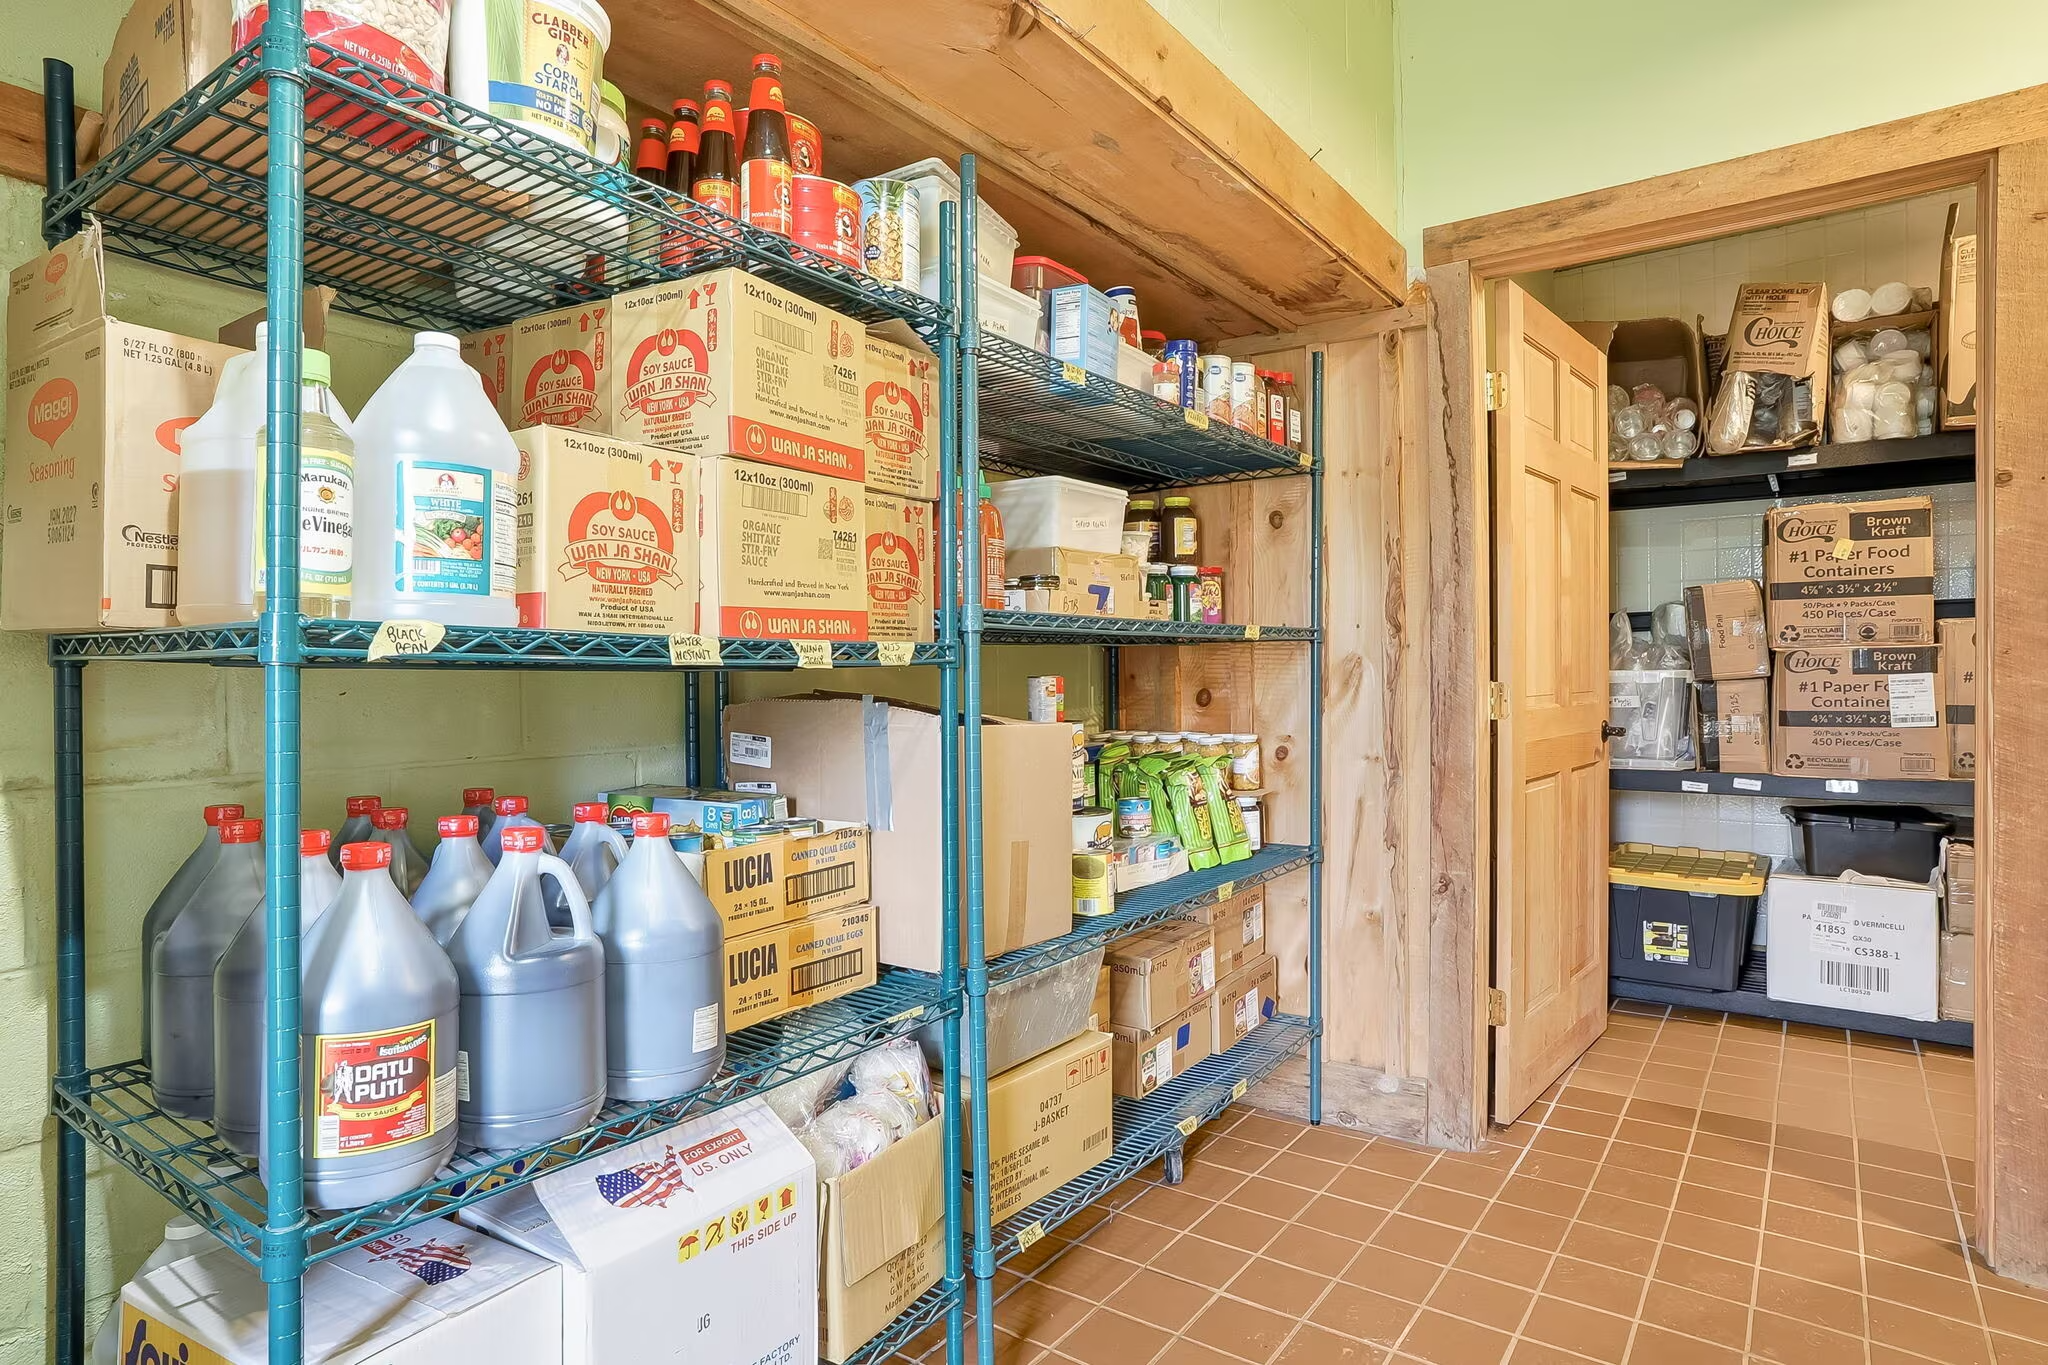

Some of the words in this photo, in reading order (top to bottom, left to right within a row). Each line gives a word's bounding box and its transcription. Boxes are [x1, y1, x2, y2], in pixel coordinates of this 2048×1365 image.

[532, 13, 589, 48] CLABBER
[548, 27, 578, 49] GIRL
[543, 63, 578, 87] CORN
[535, 72, 583, 102] STARCH
[624, 296, 654, 309] 12x10oz
[655, 290, 683, 304] (300ml)
[743, 281, 783, 310] 12x10oz
[784, 298, 818, 325] (300ml)
[1744, 316, 1804, 348] CHOICE
[123, 348, 141, 359] NET
[145, 353, 162, 364] 1.25
[165, 357, 182, 368] GAL
[185, 362, 202, 372] (4.8
[149, 343, 158, 353] FL
[162, 346, 173, 356] OZ
[176, 349, 195, 361] (800
[755, 346, 789, 367] ORGANIC
[643, 363, 661, 376] SOY
[663, 358, 693, 373] SAUCE
[833, 364, 857, 381] 74261
[756, 370, 788, 388] STIR-FRY
[628, 384, 652, 401] WAN
[659, 378, 675, 391] JA
[676, 376, 706, 391] SHAN
[757, 381, 779, 397] SAUCE
[34, 393, 72, 424] Maggi
[875, 405, 888, 416] SOY
[890, 408, 913, 423] SAUCE
[887, 421, 897, 433] JA
[900, 427, 922, 445] SHAN
[564, 438, 605, 455] 12x10oz
[607, 446, 643, 463] (300ml)
[770, 436, 800, 458] WAN
[802, 445, 815, 461] JA
[818, 449, 847, 468] SHAN
[29, 455, 76, 483] Seasoning
[733, 469, 777, 487] 12x10oz
[779, 476, 814, 494] (300ml)
[742, 520, 782, 533] ORGANIC
[1777, 517, 1838, 543] CHOICE
[1866, 515, 1911, 527] Brown
[591, 524, 615, 537] SOY
[618, 528, 656, 542] SAUCE
[742, 531, 781, 546] SHIITAKE
[832, 530, 857, 544] 74261
[1871, 526, 1907, 537] Kraft
[571, 543, 608, 562] WAN
[614, 544, 630, 557] JA
[634, 546, 672, 570] SHAN
[741, 543, 778, 557] STIR-FRY
[1789, 551, 1809, 563] #1
[1815, 549, 1862, 564] Paer
[1868, 544, 1910, 559] Food
[741, 554, 768, 568] SAUCE
[872, 558, 885, 567] SOY
[886, 559, 909, 569] SAUCE
[596, 566, 612, 580] NEW
[613, 568, 631, 582] YORK
[638, 570, 651, 583] USA
[1804, 564, 1895, 578] Containers
[592, 584, 628, 595] NATURALLY
[747, 578, 784, 587] Handcrafted
[785, 579, 796, 587] and
[797, 580, 817, 589] Brewed
[884, 572, 894, 582] JA
[895, 574, 918, 590] SHAN
[1802, 611, 1823, 619] 450
[1826, 609, 1896, 619] Pieces/Case
[387, 626, 426, 643] BLACK
[768, 618, 800, 634] WAN
[802, 618, 814, 634] JA
[817, 620, 850, 634] SHAN
[673, 636, 702, 646] WATER
[1784, 649, 1842, 674] CHOICE
[1873, 651, 1917, 661] Brown
[1878, 661, 1913, 671] Kraft
[1799, 681, 1818, 693] #1
[1823, 680, 1870, 695] Paper
[1874, 680, 1889, 692] Fo
[1811, 696, 1890, 708] Container
[1835, 738, 1902, 748] Pieces/Case
[707, 807, 716, 820] 8
[791, 848, 818, 861] CANNED
[839, 840, 856, 852] EGGS
[724, 852, 773, 894] LUCIA
[842, 914, 869, 927] 210345
[1816, 924, 1846, 935] 41853
[1861, 921, 1905, 931] VERMICELLI
[796, 940, 823, 953] CANNED
[825, 934, 845, 946] QUAIL
[846, 929, 864, 941] EGGS
[1855, 947, 1900, 960] CS388-1
[729, 942, 778, 988] LUCIA
[1113, 964, 1143, 976] 350mL
[355, 1057, 413, 1083] DATU
[355, 1079, 404, 1103] PUTI
[374, 1106, 398, 1117] SAUCE
[1040, 1093, 1062, 1112] 04737
[1034, 1105, 1069, 1132] J-BASKET
[684, 1148, 705, 1161] FOR
[705, 1132, 740, 1152] EXPORT
[1002, 1151, 1017, 1166] PURE
[1018, 1139, 1040, 1158] SESAME
[692, 1162, 718, 1176] US.
[719, 1143, 753, 1165] ONLY
[995, 1173, 1039, 1202] INTERNATIONAL
[996, 1193, 1022, 1214] ANGELES
[731, 1234, 754, 1253] THIS
[758, 1220, 780, 1240] SIDE
[784, 1212, 797, 1227] UP
[368, 1242, 388, 1253] FOR
[884, 1294, 902, 1314] Made
[760, 1334, 800, 1365] FACTORY
